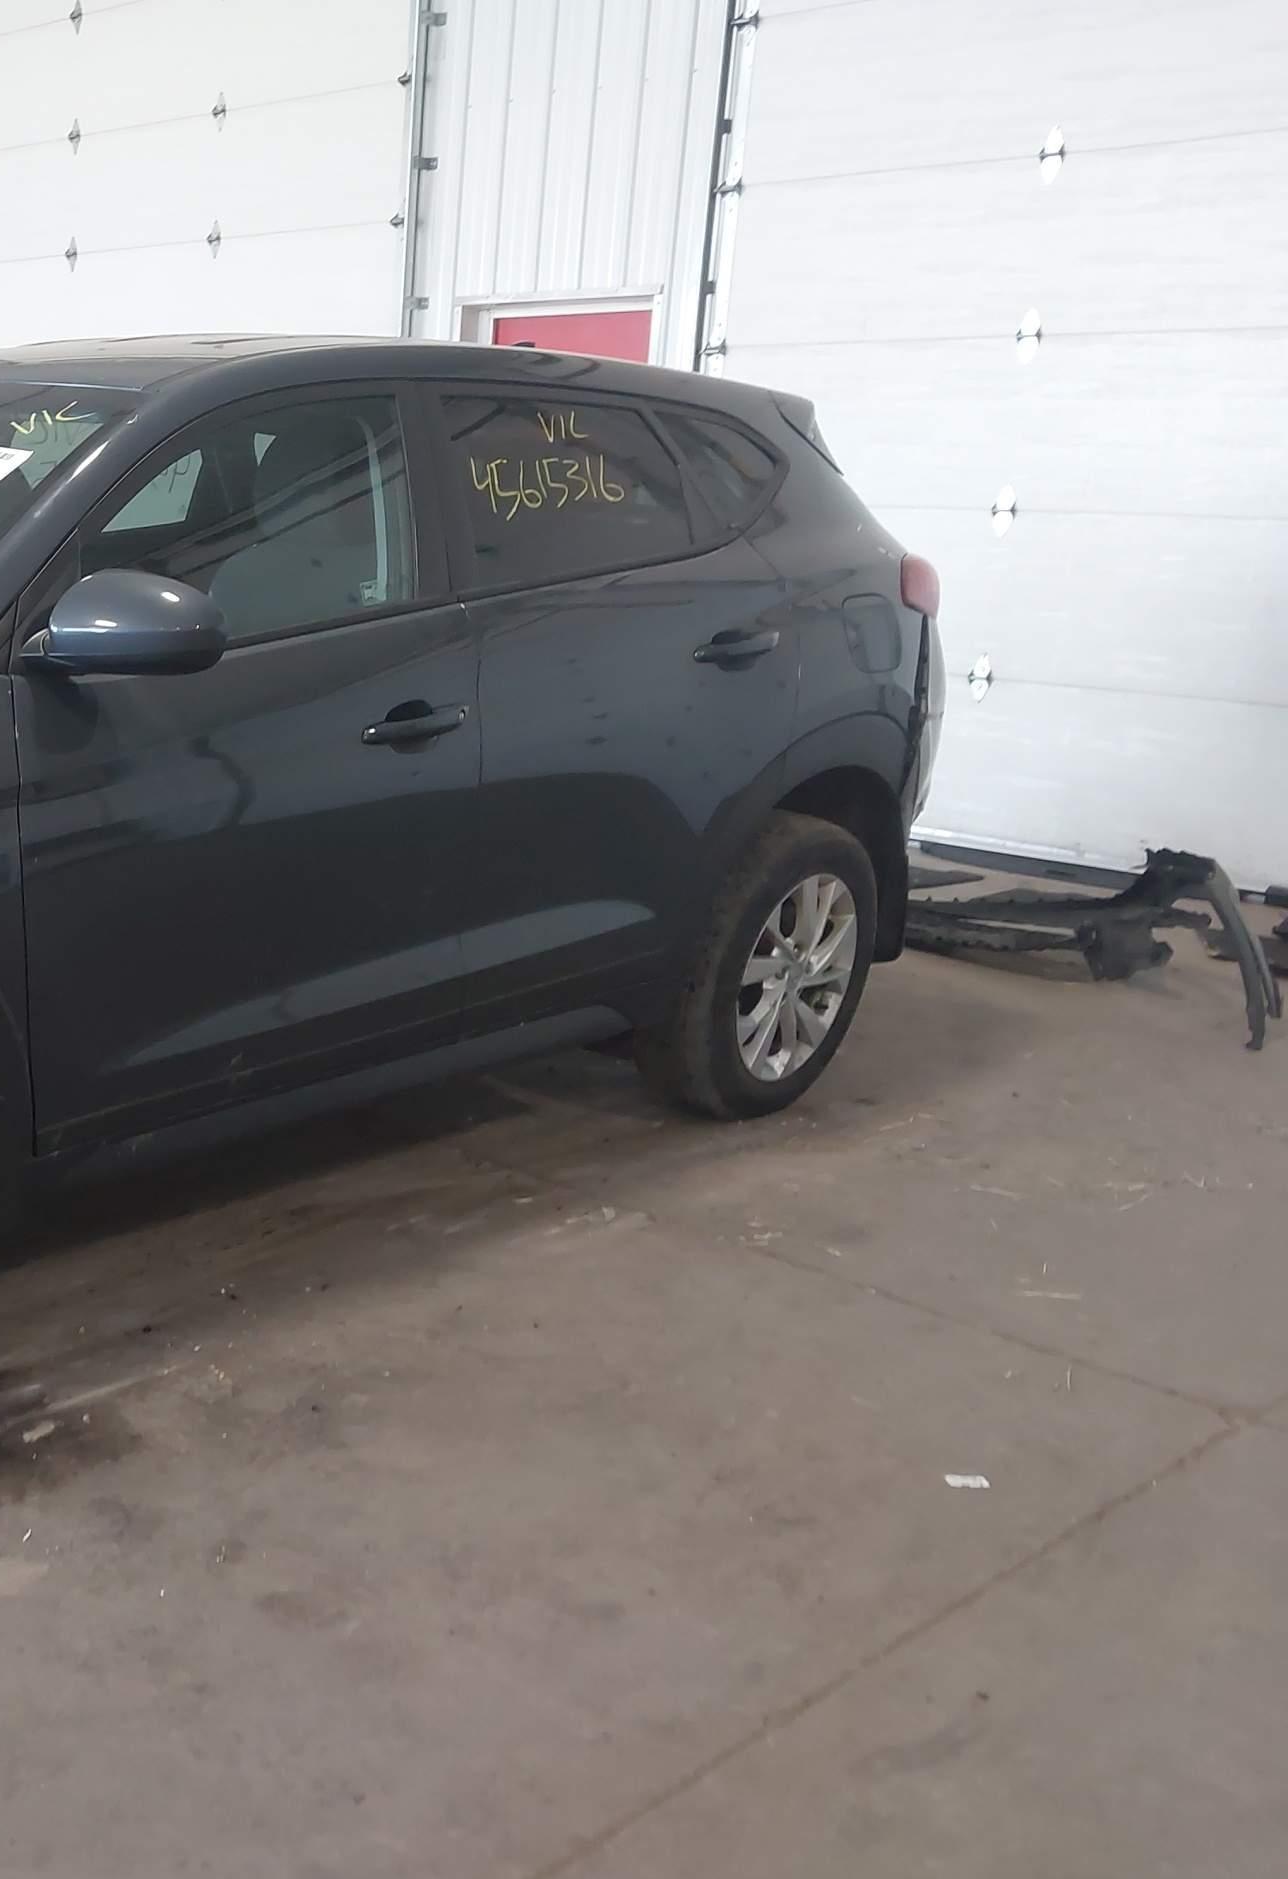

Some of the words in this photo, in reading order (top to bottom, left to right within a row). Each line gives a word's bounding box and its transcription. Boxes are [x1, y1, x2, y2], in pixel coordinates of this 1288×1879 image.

[10, 400, 97, 435] VIC
[536, 410, 590, 443] VIC
[470, 454, 625, 521] 45615316
